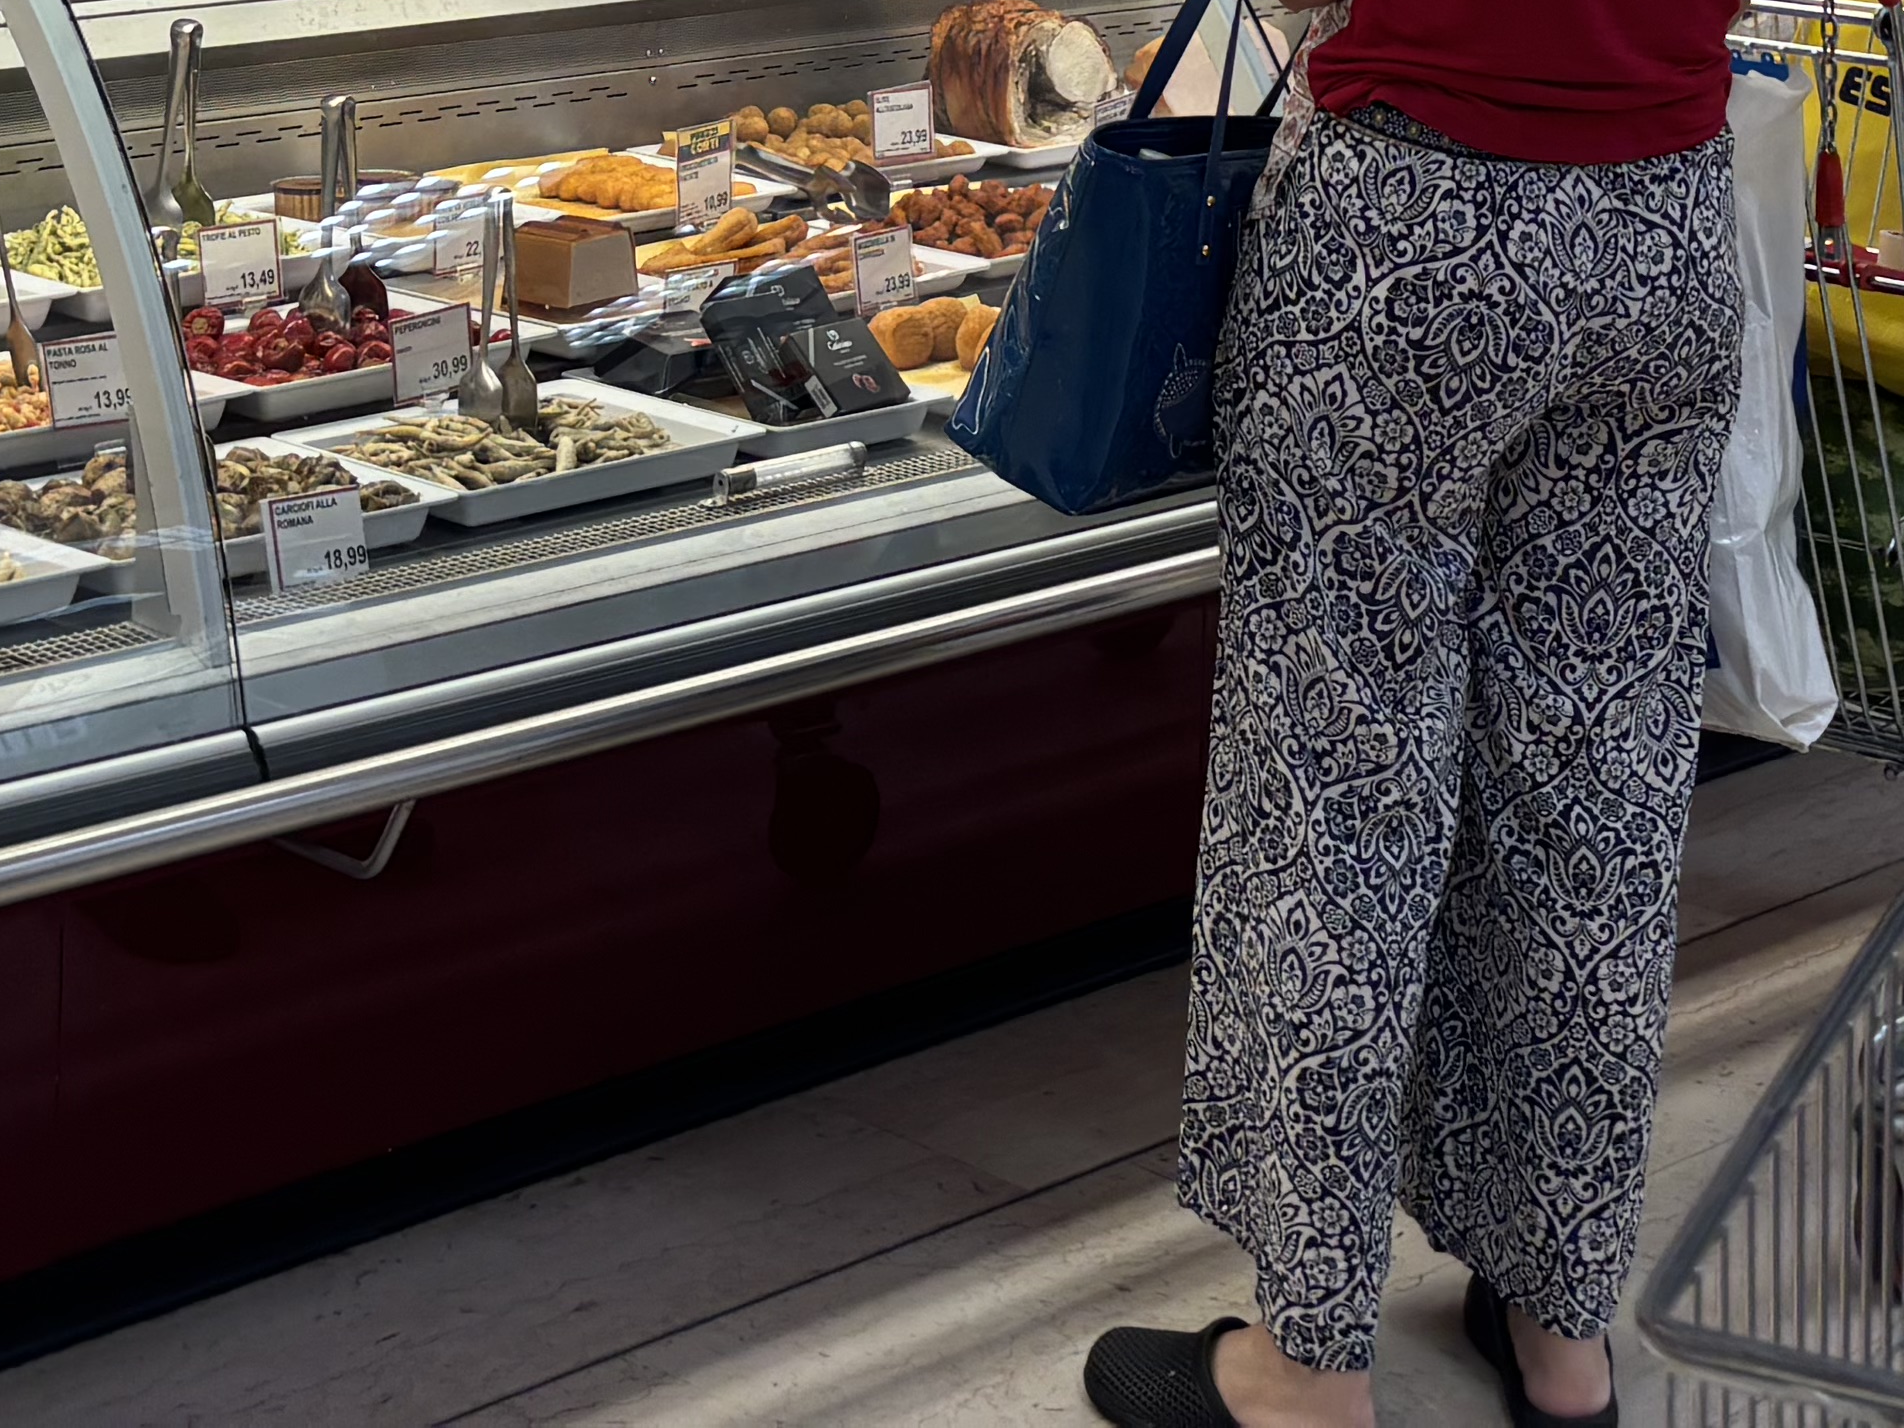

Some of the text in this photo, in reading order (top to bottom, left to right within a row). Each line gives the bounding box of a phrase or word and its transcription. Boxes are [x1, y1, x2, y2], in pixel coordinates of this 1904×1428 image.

[201, 227, 261, 242] TROFIE AL PESTO
[240, 269, 274, 288] 13,49
[46, 342, 108, 357] PASTA ROSA AL
[48, 358, 77, 372] TONNO
[432, 355, 468, 379] 30,99
[274, 496, 338, 515] CARCIOFI ALLA
[276, 515, 314, 529] ROMANA
[324, 544, 367, 571] 18,99
